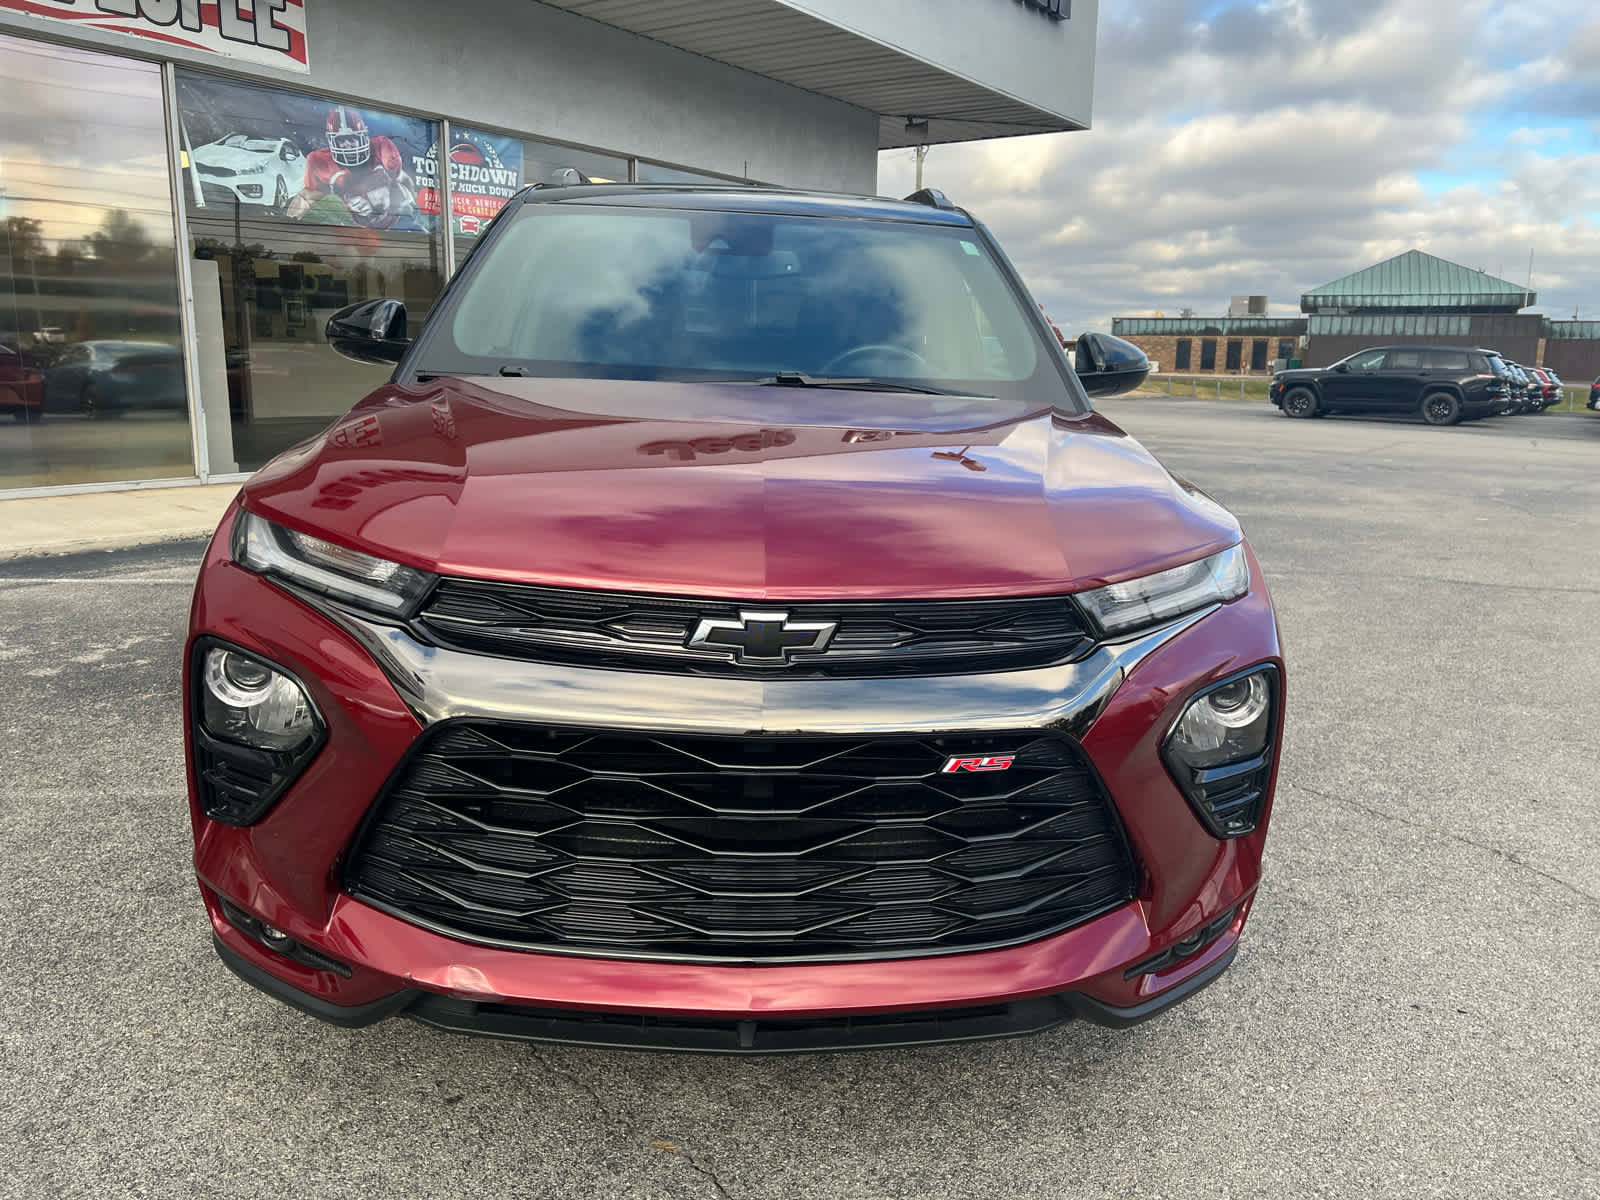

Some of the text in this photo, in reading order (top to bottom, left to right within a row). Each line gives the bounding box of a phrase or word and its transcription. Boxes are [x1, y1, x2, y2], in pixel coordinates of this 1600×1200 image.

[412, 156, 518, 187] TOCHDOWN
[415, 176, 435, 188] FOR
[458, 182, 487, 194] MUCH
[942, 755, 1016, 773] RS
